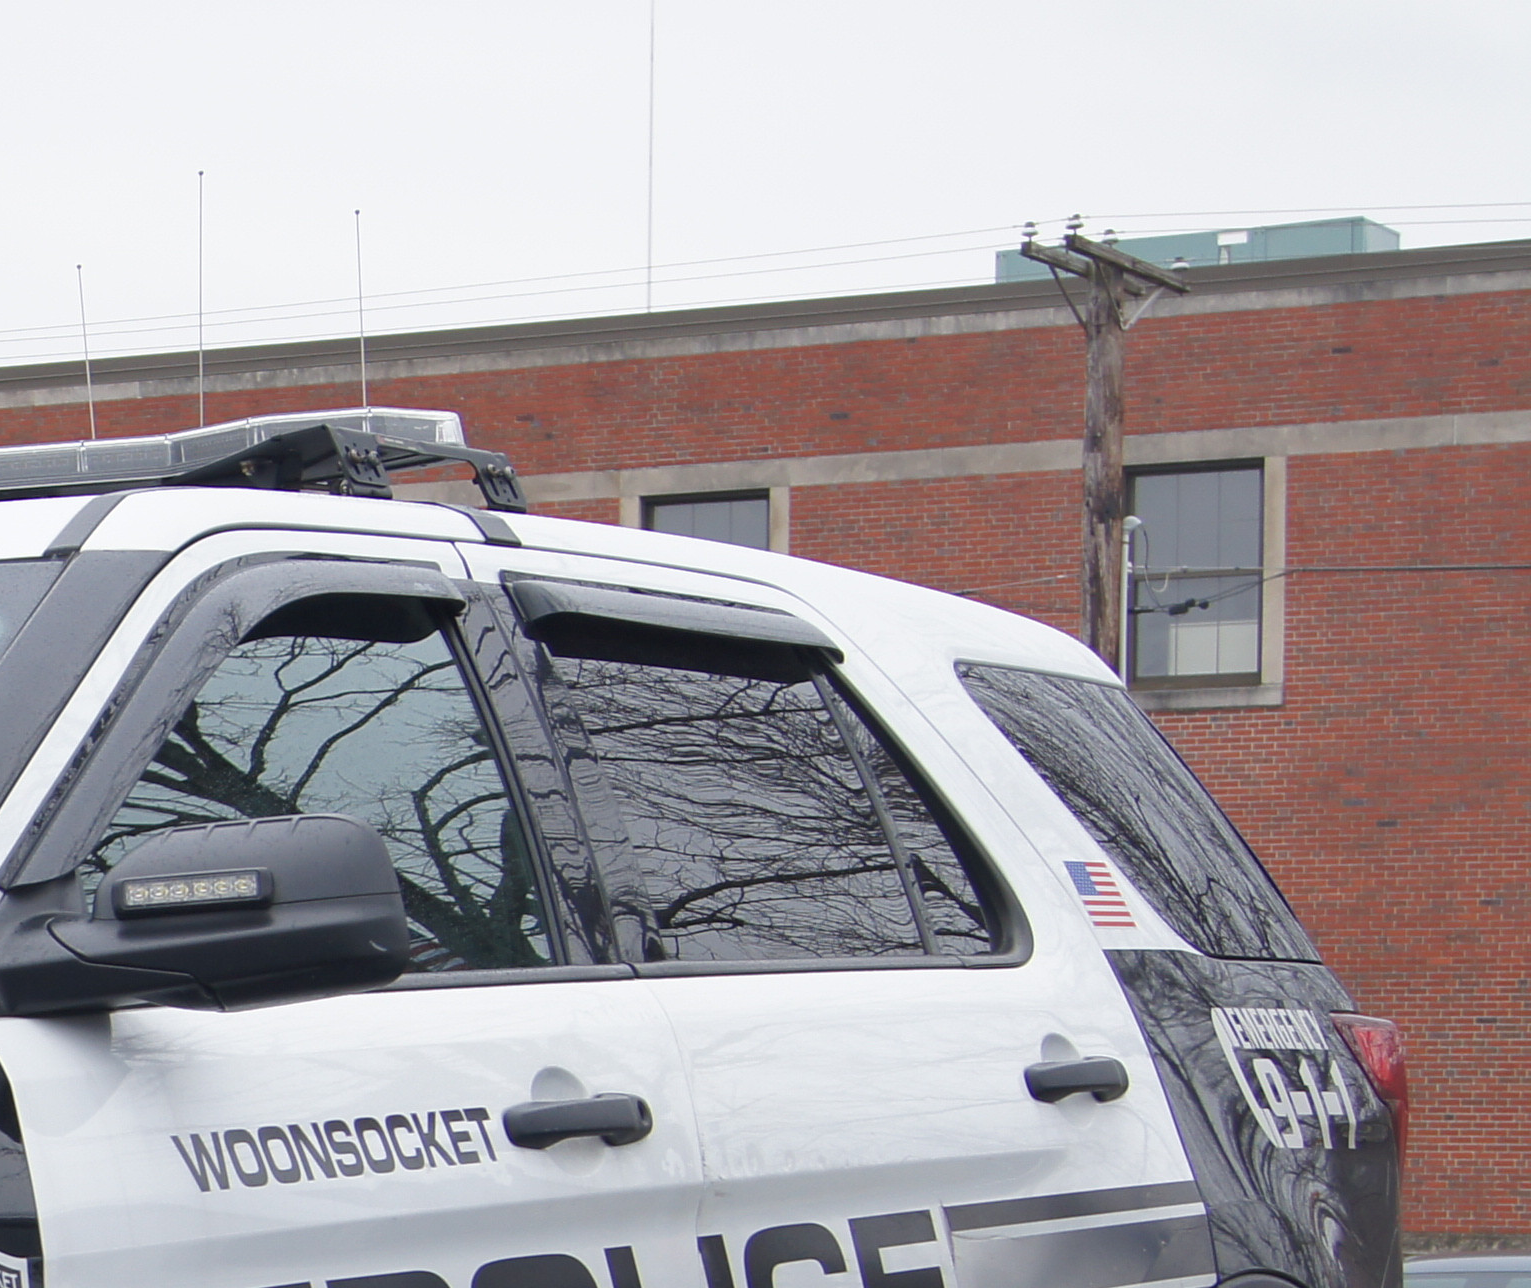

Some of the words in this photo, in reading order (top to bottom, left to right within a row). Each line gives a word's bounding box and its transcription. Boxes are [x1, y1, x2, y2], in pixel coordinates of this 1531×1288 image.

[1224, 1007, 1329, 1050] EMERGENCY
[1252, 1058, 1357, 1149] 9-1-1
[170, 1107, 497, 1192] WOONSOCKET
